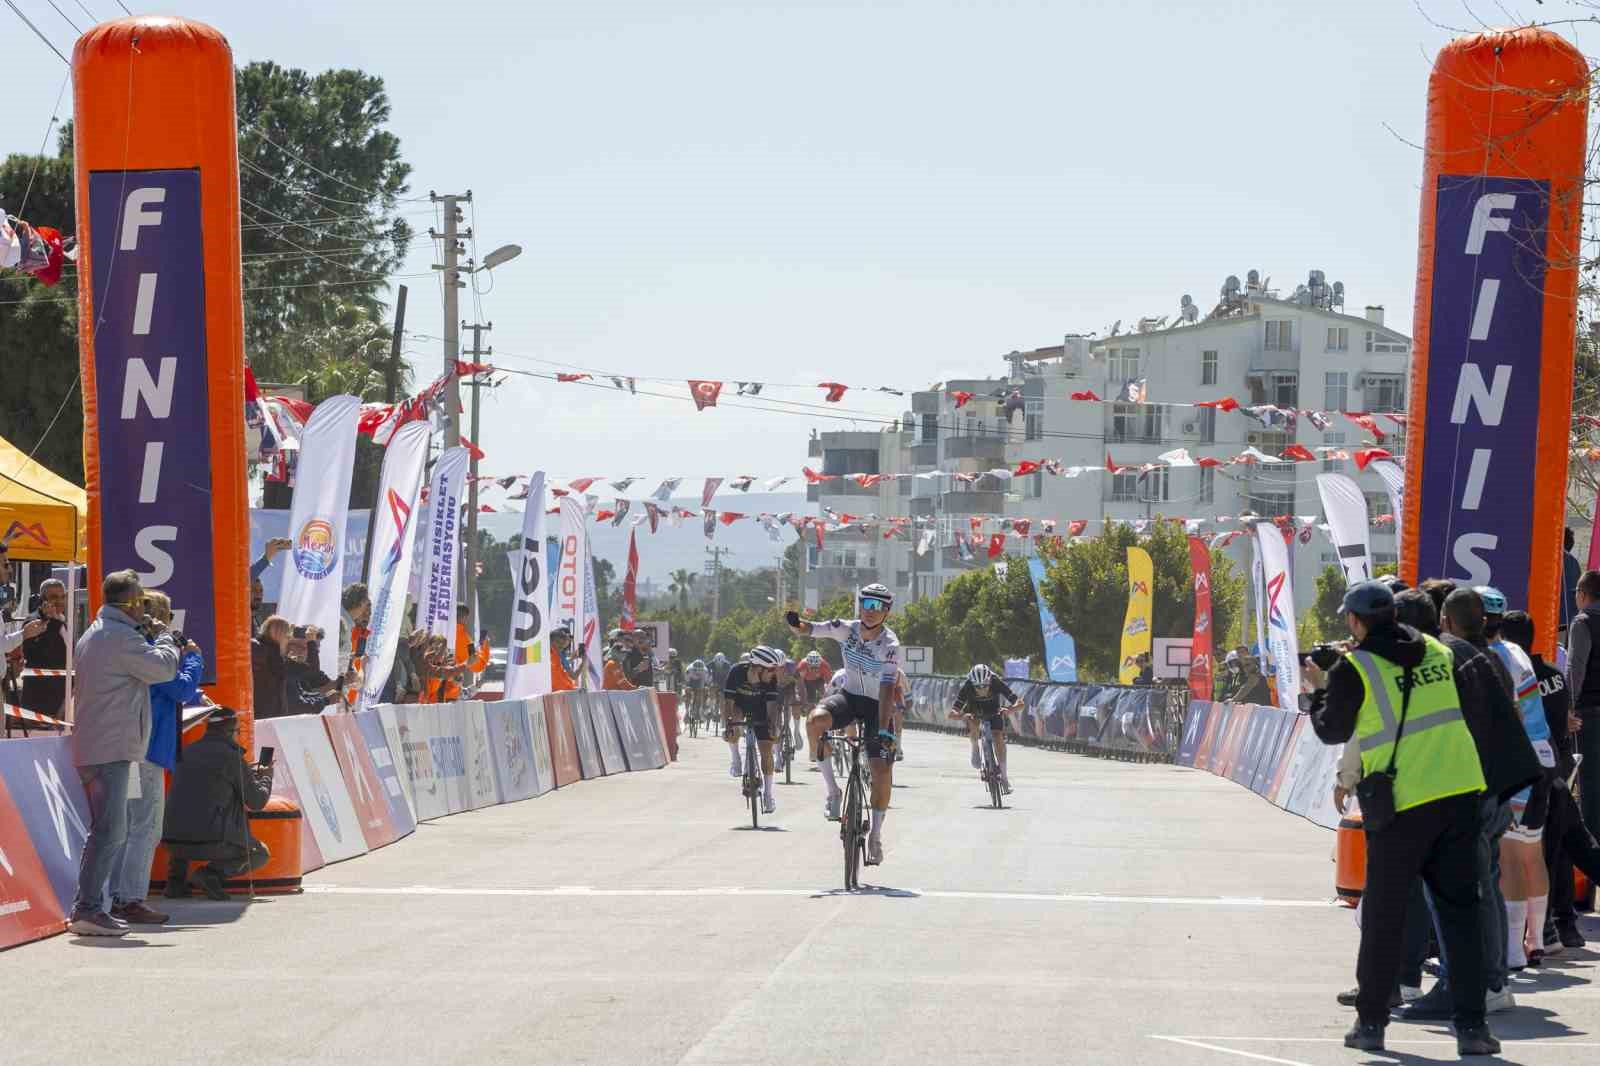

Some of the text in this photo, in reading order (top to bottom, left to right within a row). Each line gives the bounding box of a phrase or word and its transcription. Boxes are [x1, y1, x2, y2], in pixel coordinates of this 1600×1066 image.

[119, 187, 187, 633] FINIS
[425, 473, 449, 634] ÜRKİYE BİSİKLET
[437, 496, 457, 621] FEDERASYONU
[514, 537, 542, 642] UCI
[560, 535, 577, 615] TOTO
[1395, 664, 1451, 692] PRESS
[1537, 674, 1565, 697] OLIS
